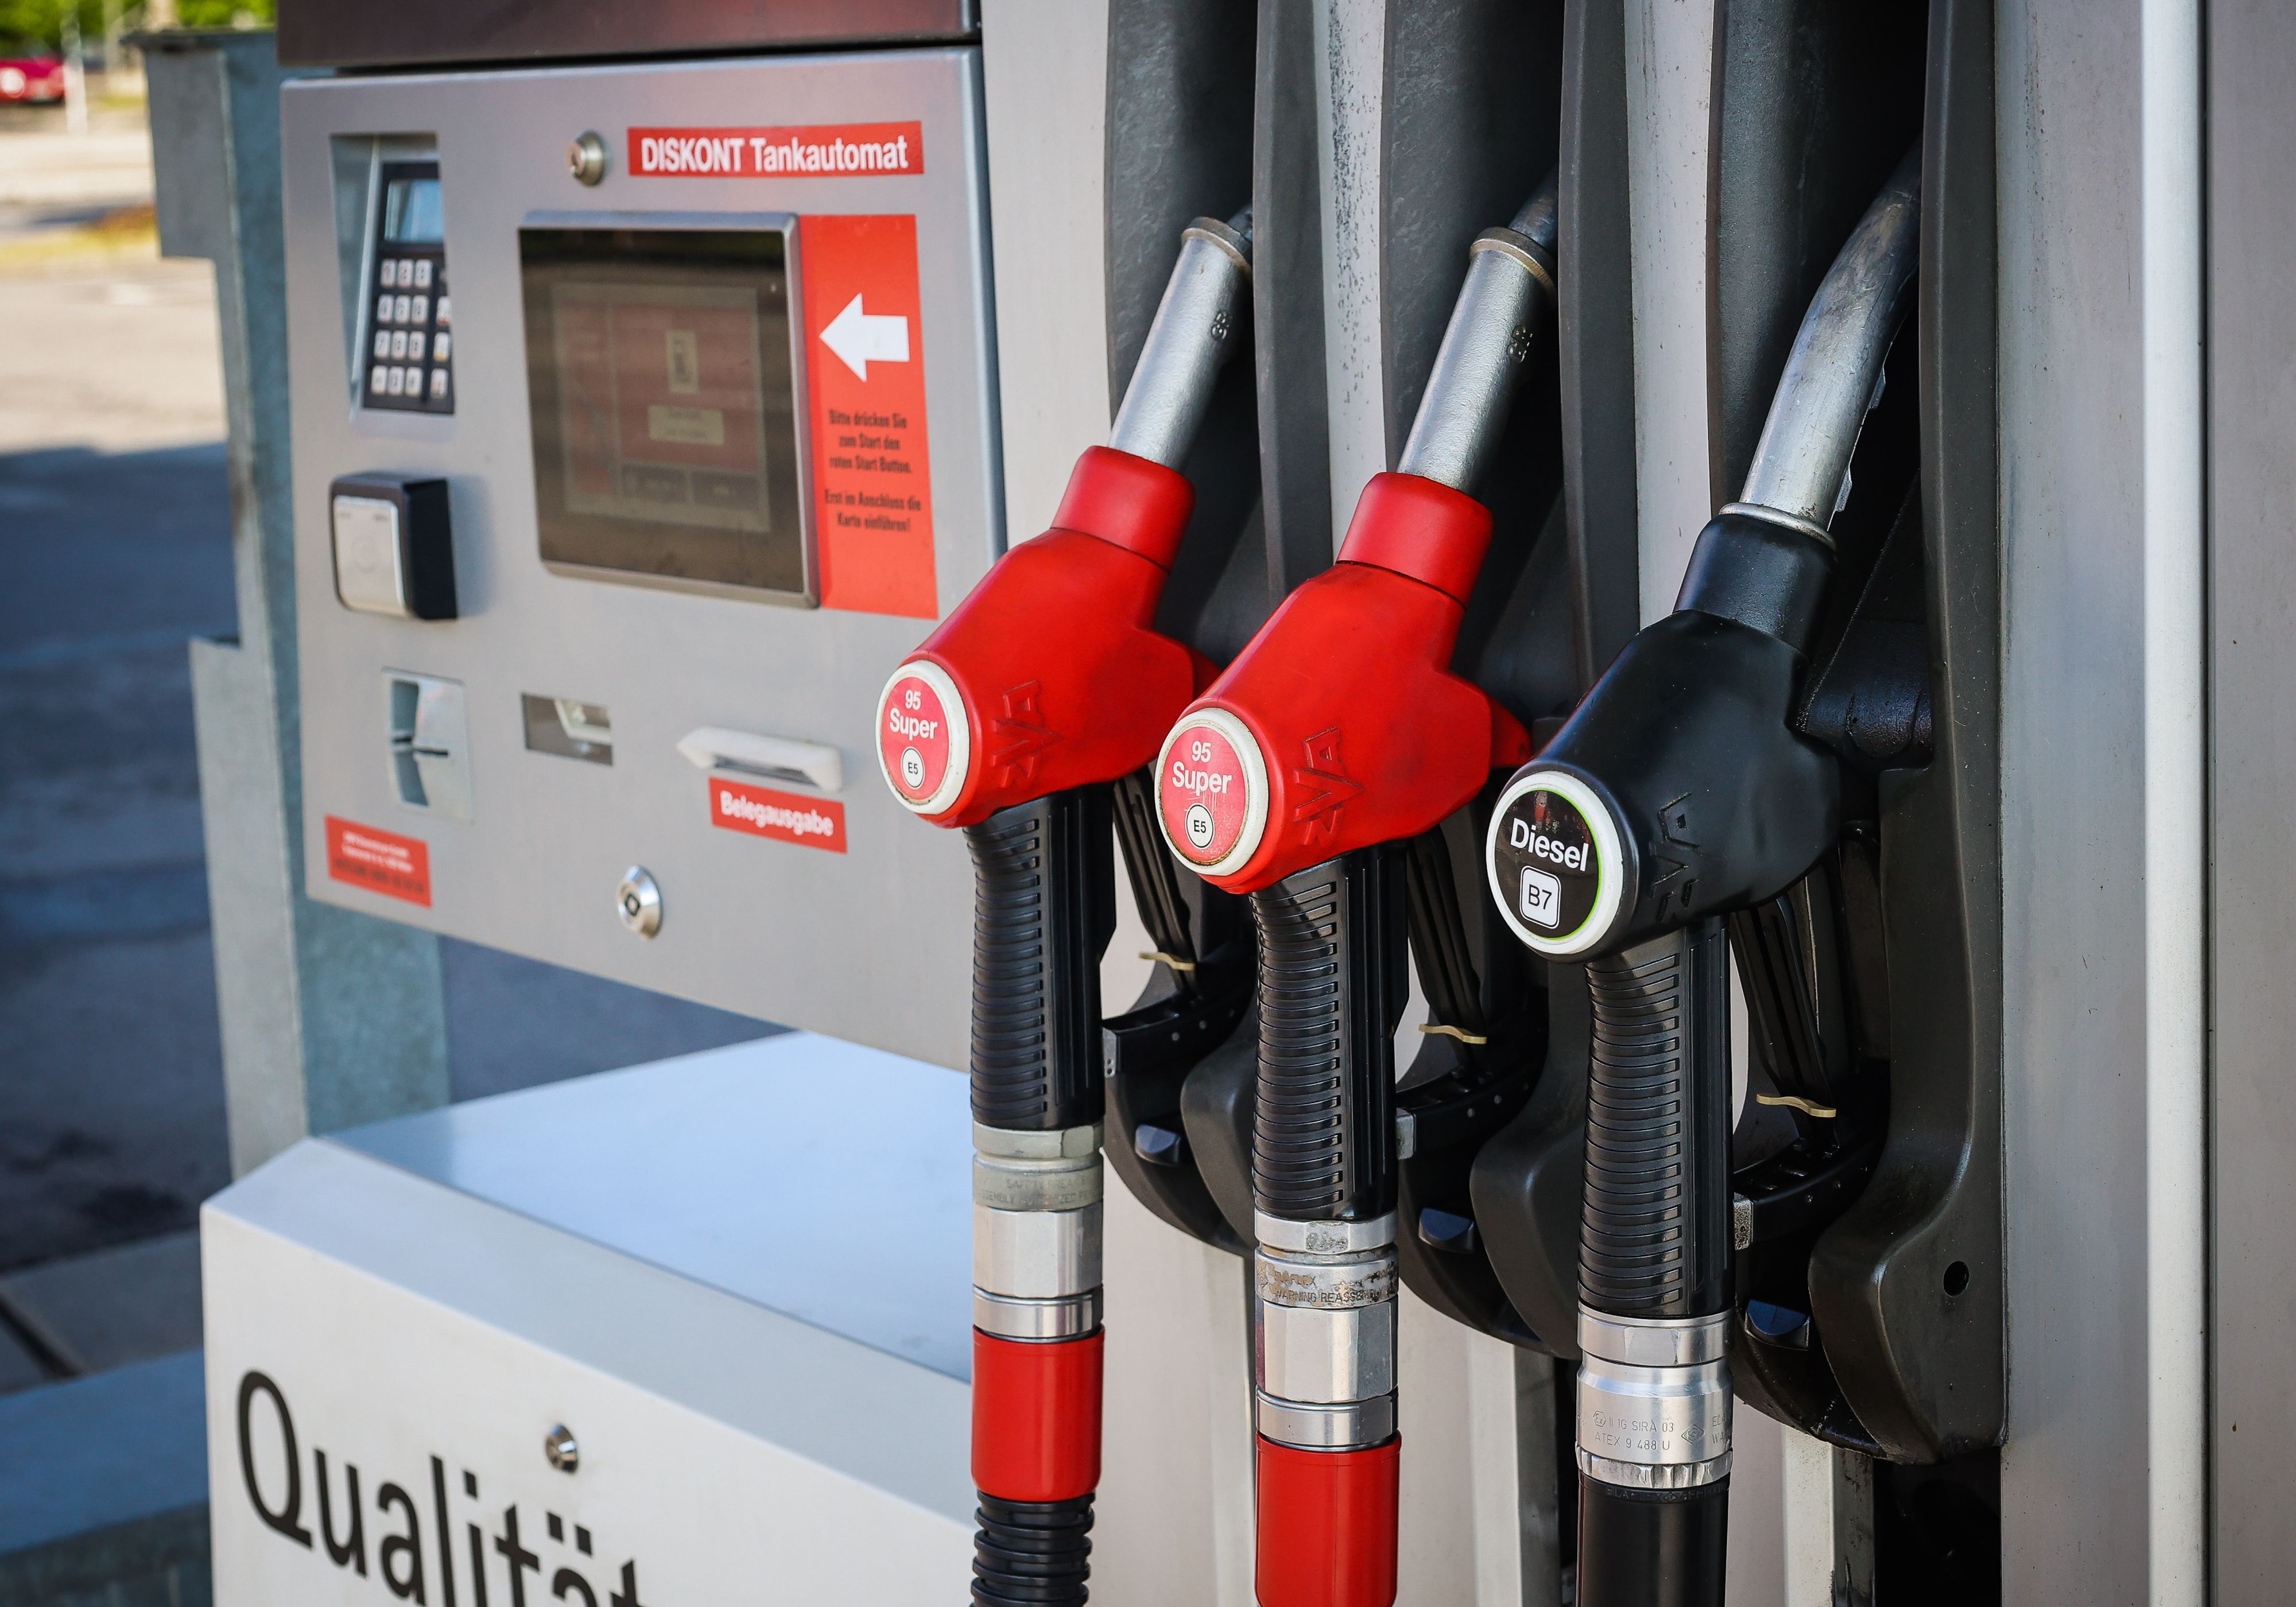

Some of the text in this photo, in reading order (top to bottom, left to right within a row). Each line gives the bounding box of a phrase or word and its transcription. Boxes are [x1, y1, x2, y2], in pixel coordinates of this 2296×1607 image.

[641, 135, 909, 173] DISKONT Tankautomat
[859, 433, 881, 449] Start
[855, 456, 877, 471] Start
[905, 689, 921, 711] 95
[889, 710, 938, 740] Super
[1192, 740, 1212, 763] 95
[908, 762, 918, 775] E5
[1172, 762, 1232, 796] Super
[720, 790, 834, 836] Belegausgabe
[1193, 820, 1207, 833] E5
[1510, 817, 1589, 872] Diesel
[1528, 884, 1553, 911] B7
[1632, 1416, 1657, 1432] SIRA
[1662, 1422, 1674, 1433] 03
[1595, 1432, 1621, 1447] ATEX
[1626, 1438, 1632, 1449] 9
[1637, 1439, 1657, 1450] 488
[1662, 1441, 1670, 1450] U
